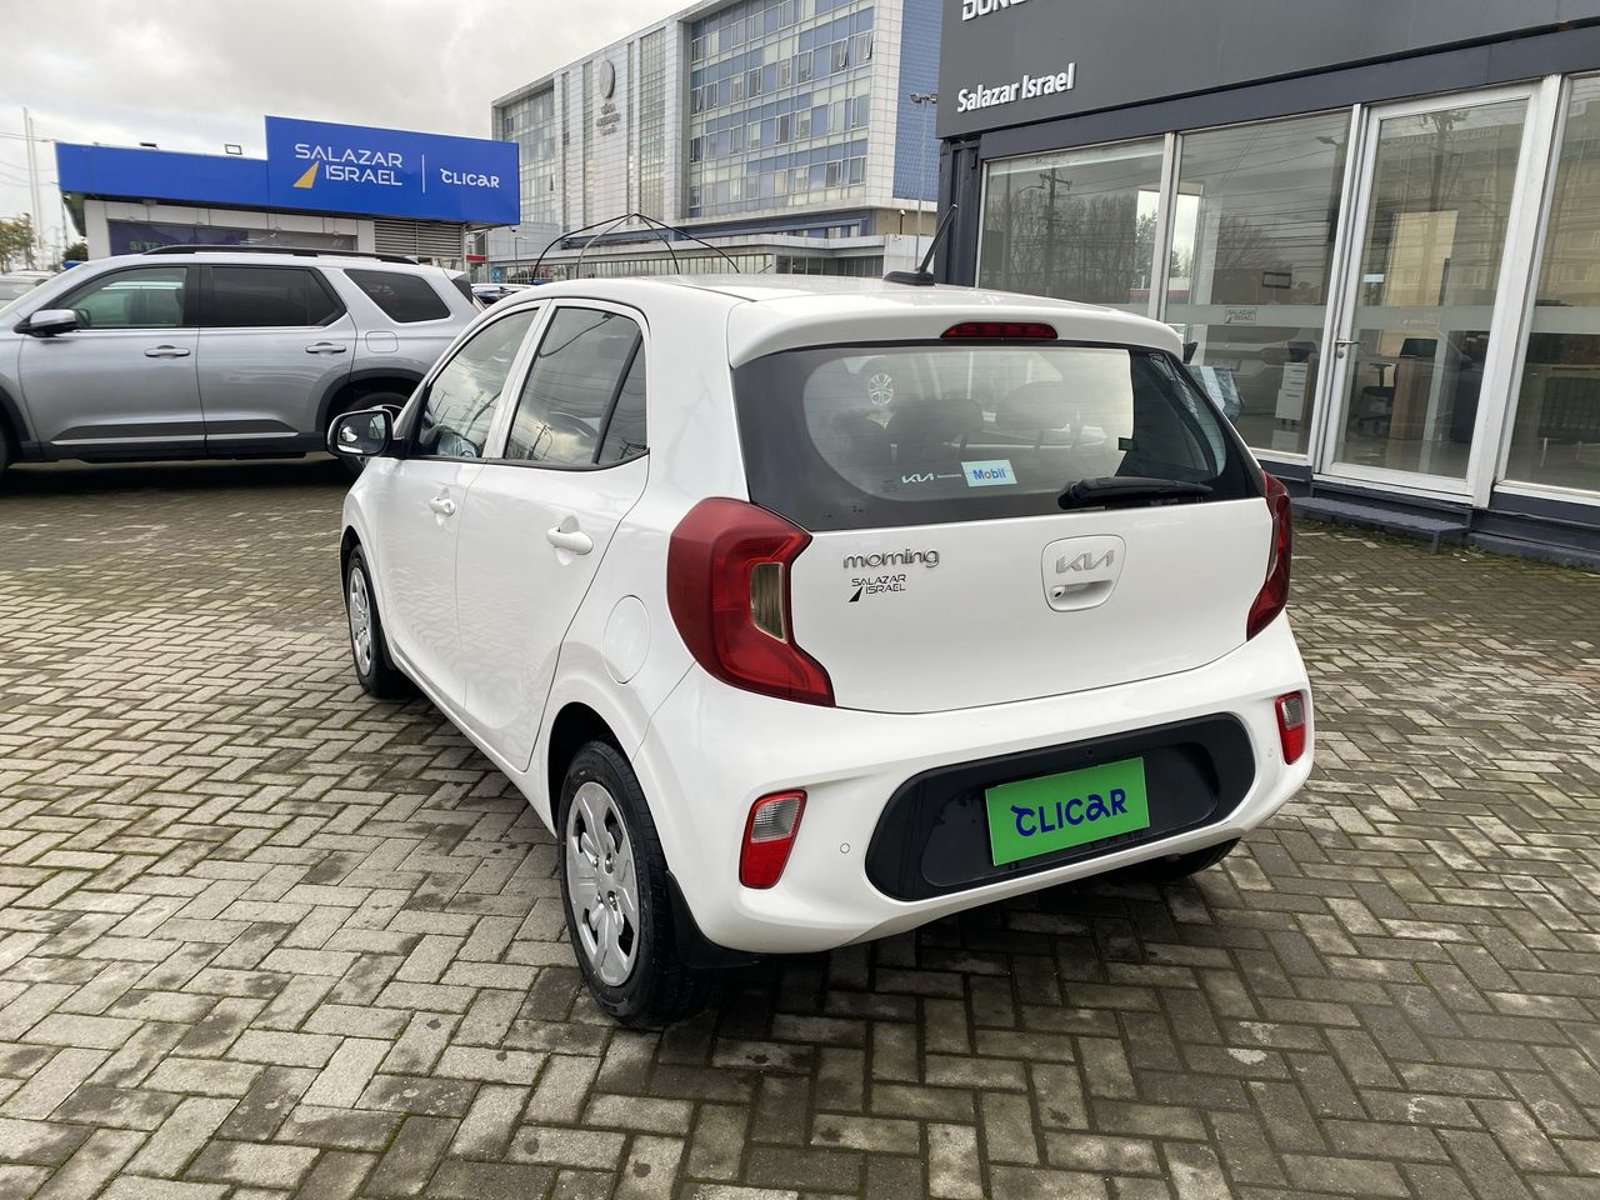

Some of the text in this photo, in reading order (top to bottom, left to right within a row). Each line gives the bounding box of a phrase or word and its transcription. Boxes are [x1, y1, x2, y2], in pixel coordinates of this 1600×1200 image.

[957, 62, 1076, 113] Salazar Israel
[294, 143, 403, 168] SALAZAR
[325, 164, 403, 186] ISRAEL
[972, 467, 1007, 481] Mobil
[843, 547, 940, 569] morning
[851, 573, 907, 588] SALAZAR
[865, 583, 907, 595] ISRAEL
